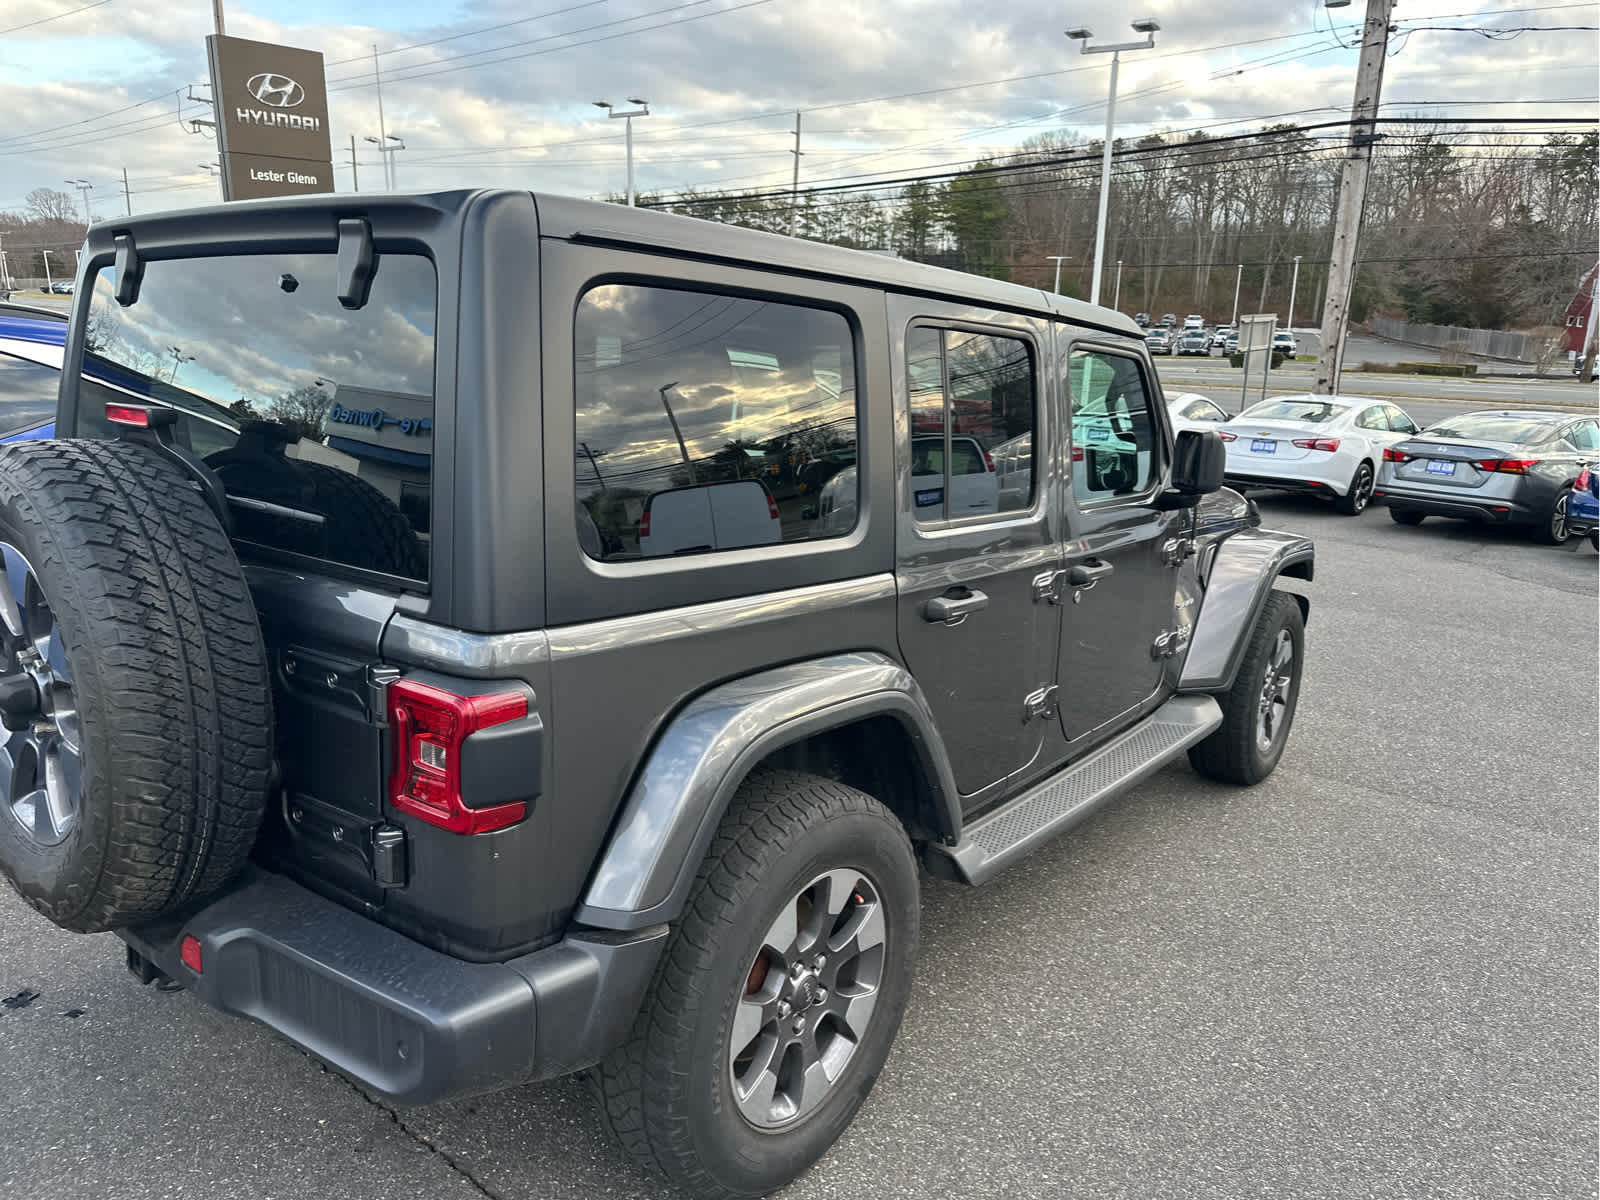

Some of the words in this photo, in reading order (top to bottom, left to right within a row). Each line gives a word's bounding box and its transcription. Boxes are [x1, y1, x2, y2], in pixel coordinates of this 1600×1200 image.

[236, 107, 320, 131] HYUNDAI
[250, 167, 284, 182] Lester
[287, 171, 318, 185] Glenn
